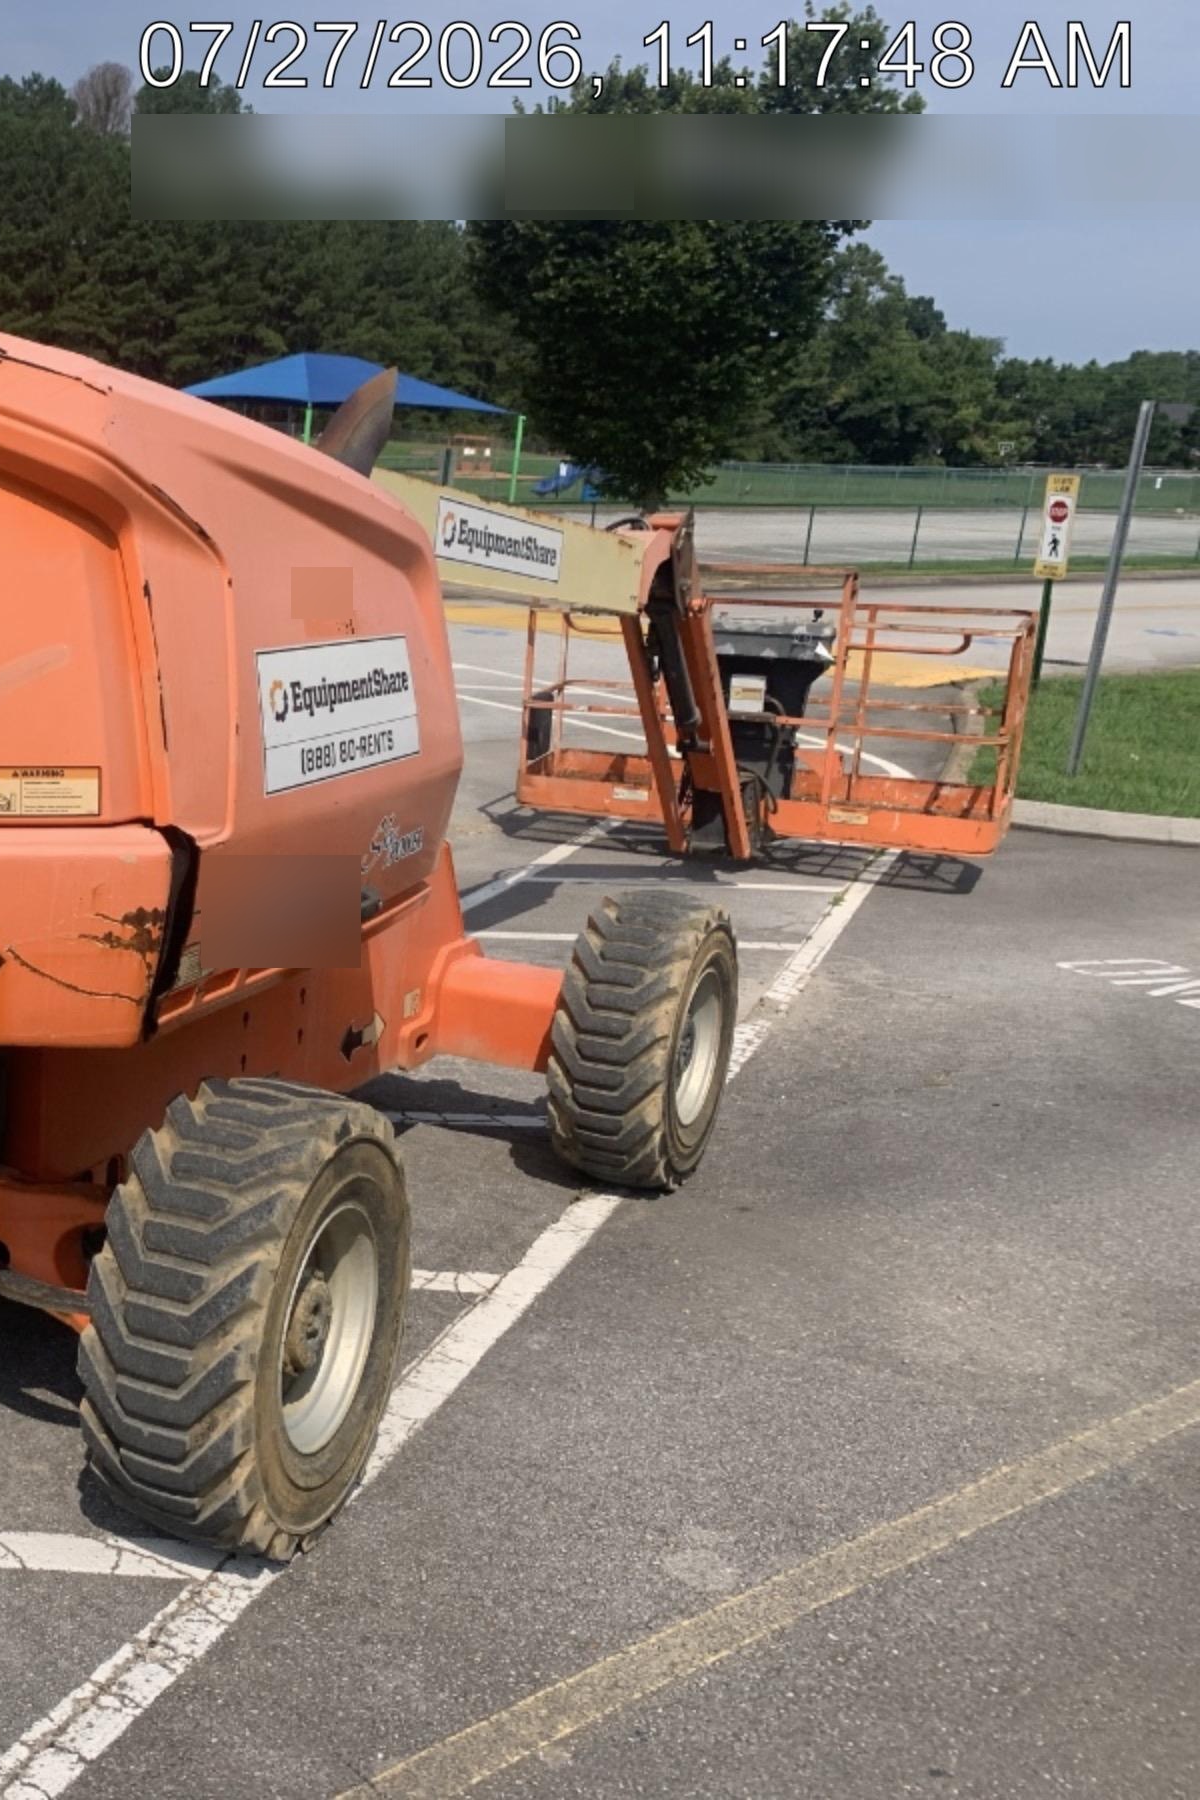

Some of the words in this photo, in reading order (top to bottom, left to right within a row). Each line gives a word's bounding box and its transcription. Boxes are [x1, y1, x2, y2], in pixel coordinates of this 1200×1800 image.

[457, 517, 558, 567] EquipmentShare
[289, 667, 409, 717] EquipmentShare
[300, 740, 336, 775] (888)
